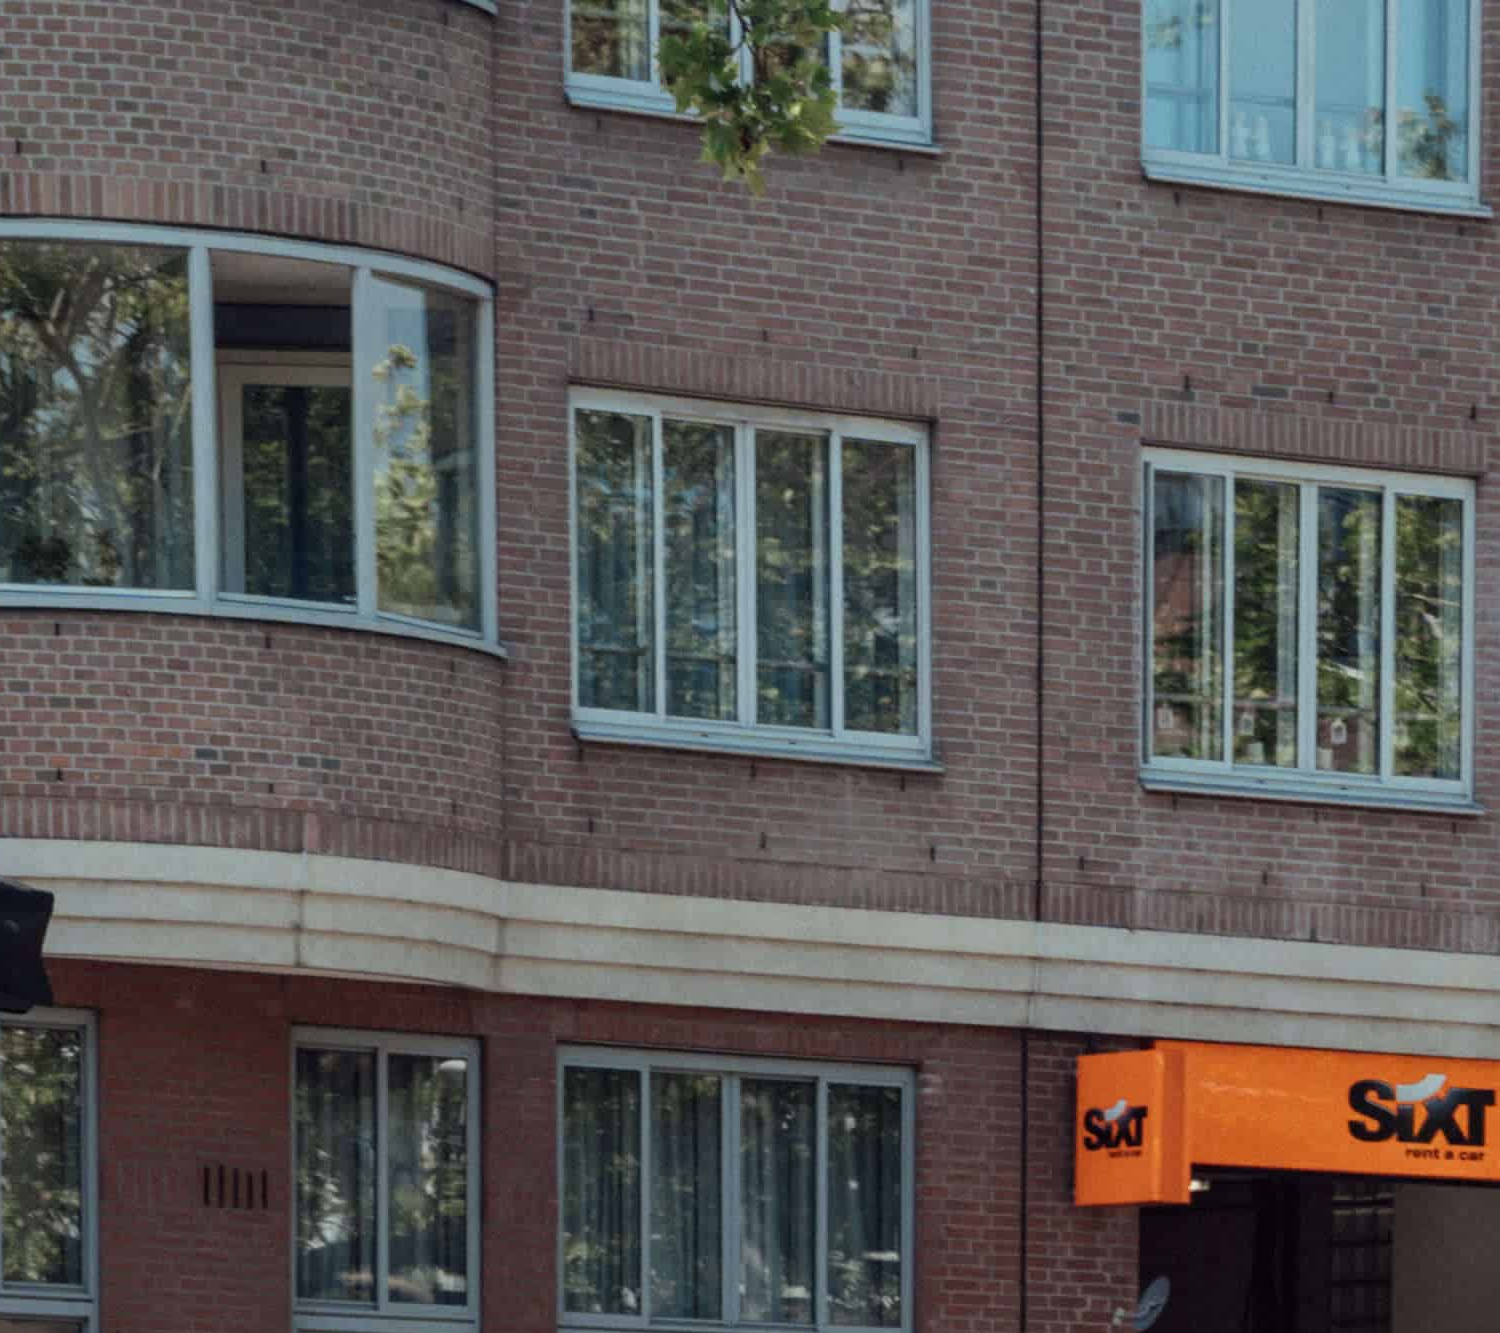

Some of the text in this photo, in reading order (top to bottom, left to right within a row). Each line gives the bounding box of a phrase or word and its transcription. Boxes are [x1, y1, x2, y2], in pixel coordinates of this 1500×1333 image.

[1405, 1148, 1486, 1161] rent a car
